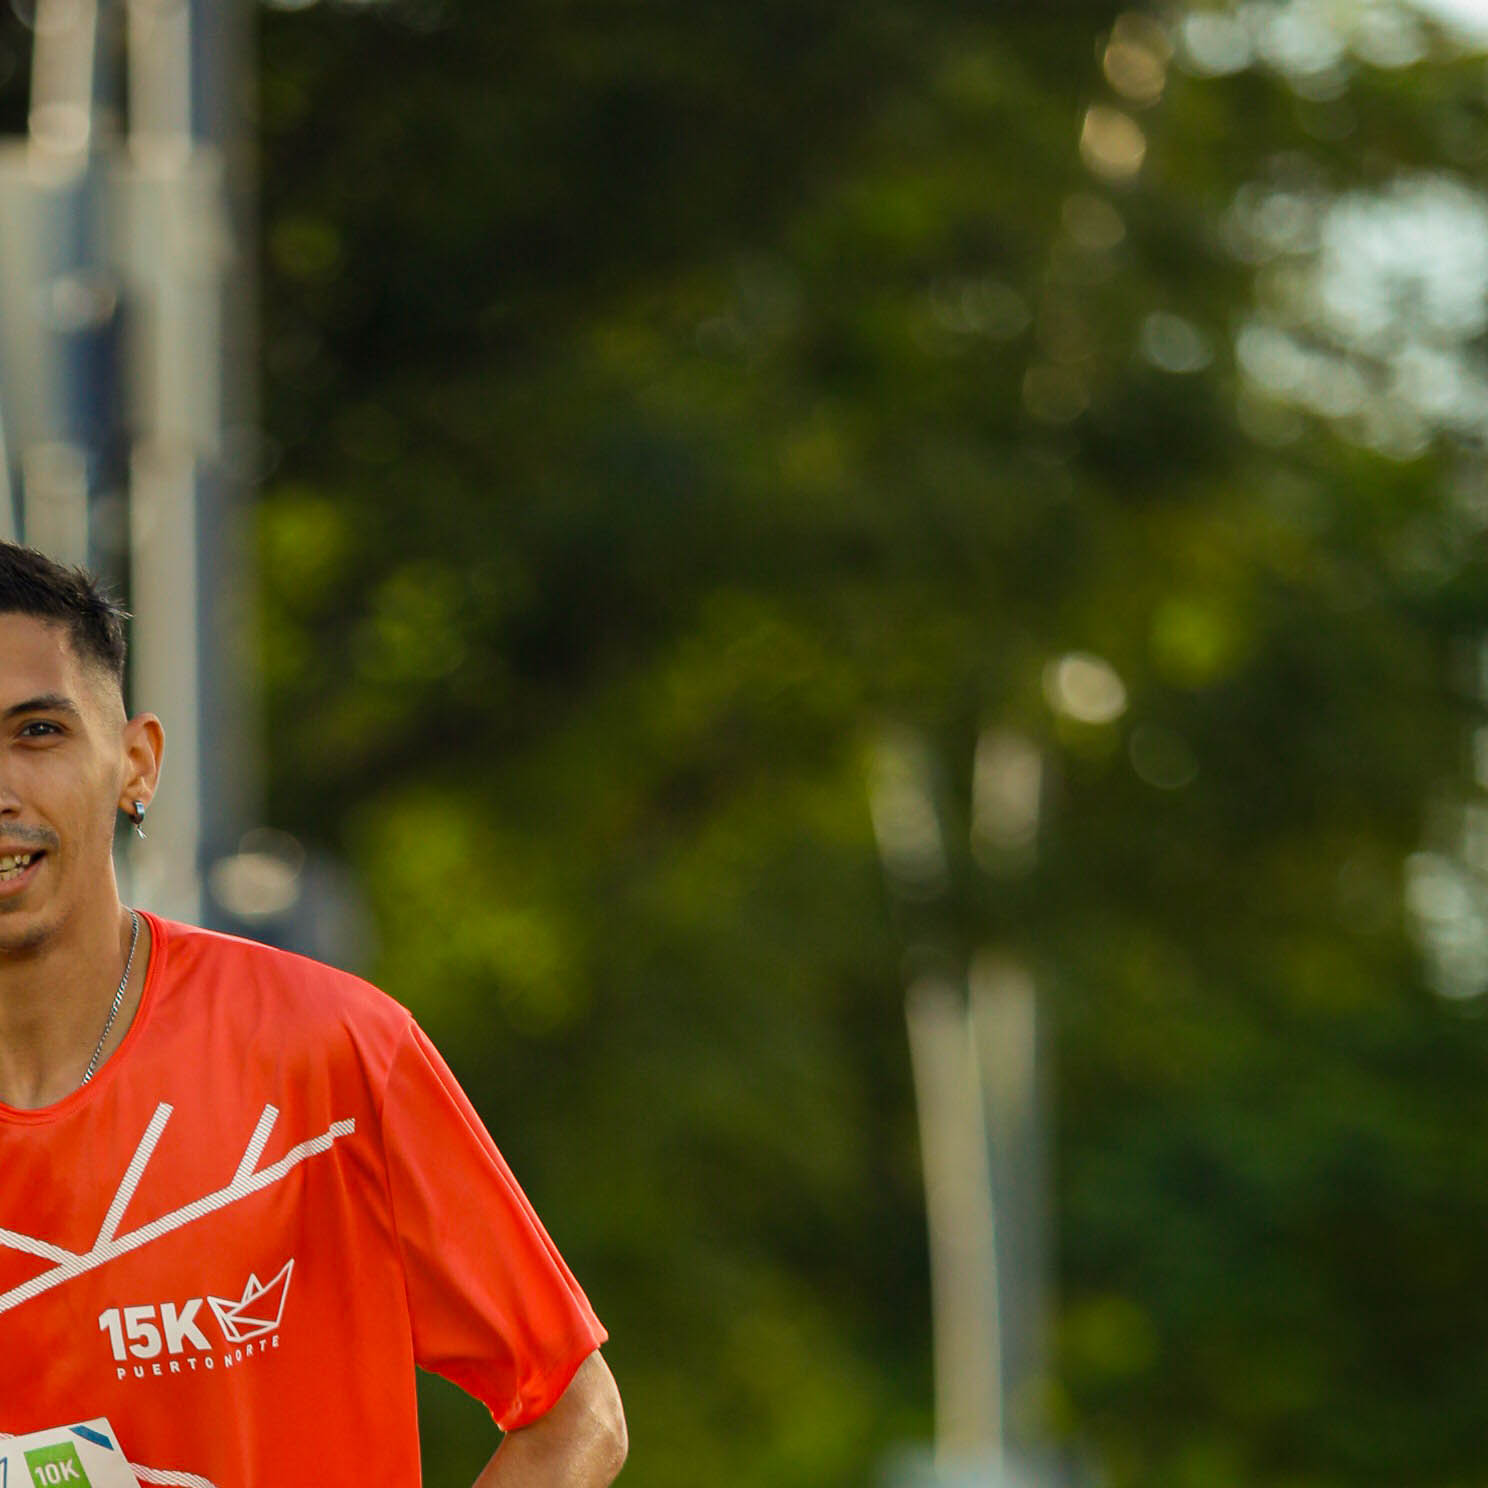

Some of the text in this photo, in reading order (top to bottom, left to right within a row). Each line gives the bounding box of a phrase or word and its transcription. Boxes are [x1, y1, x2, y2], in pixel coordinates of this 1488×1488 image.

[98, 1298, 212, 1361] 15K
[116, 1335, 280, 1380] PUERTO NORTE
[34, 1457, 81, 1487] 10K
